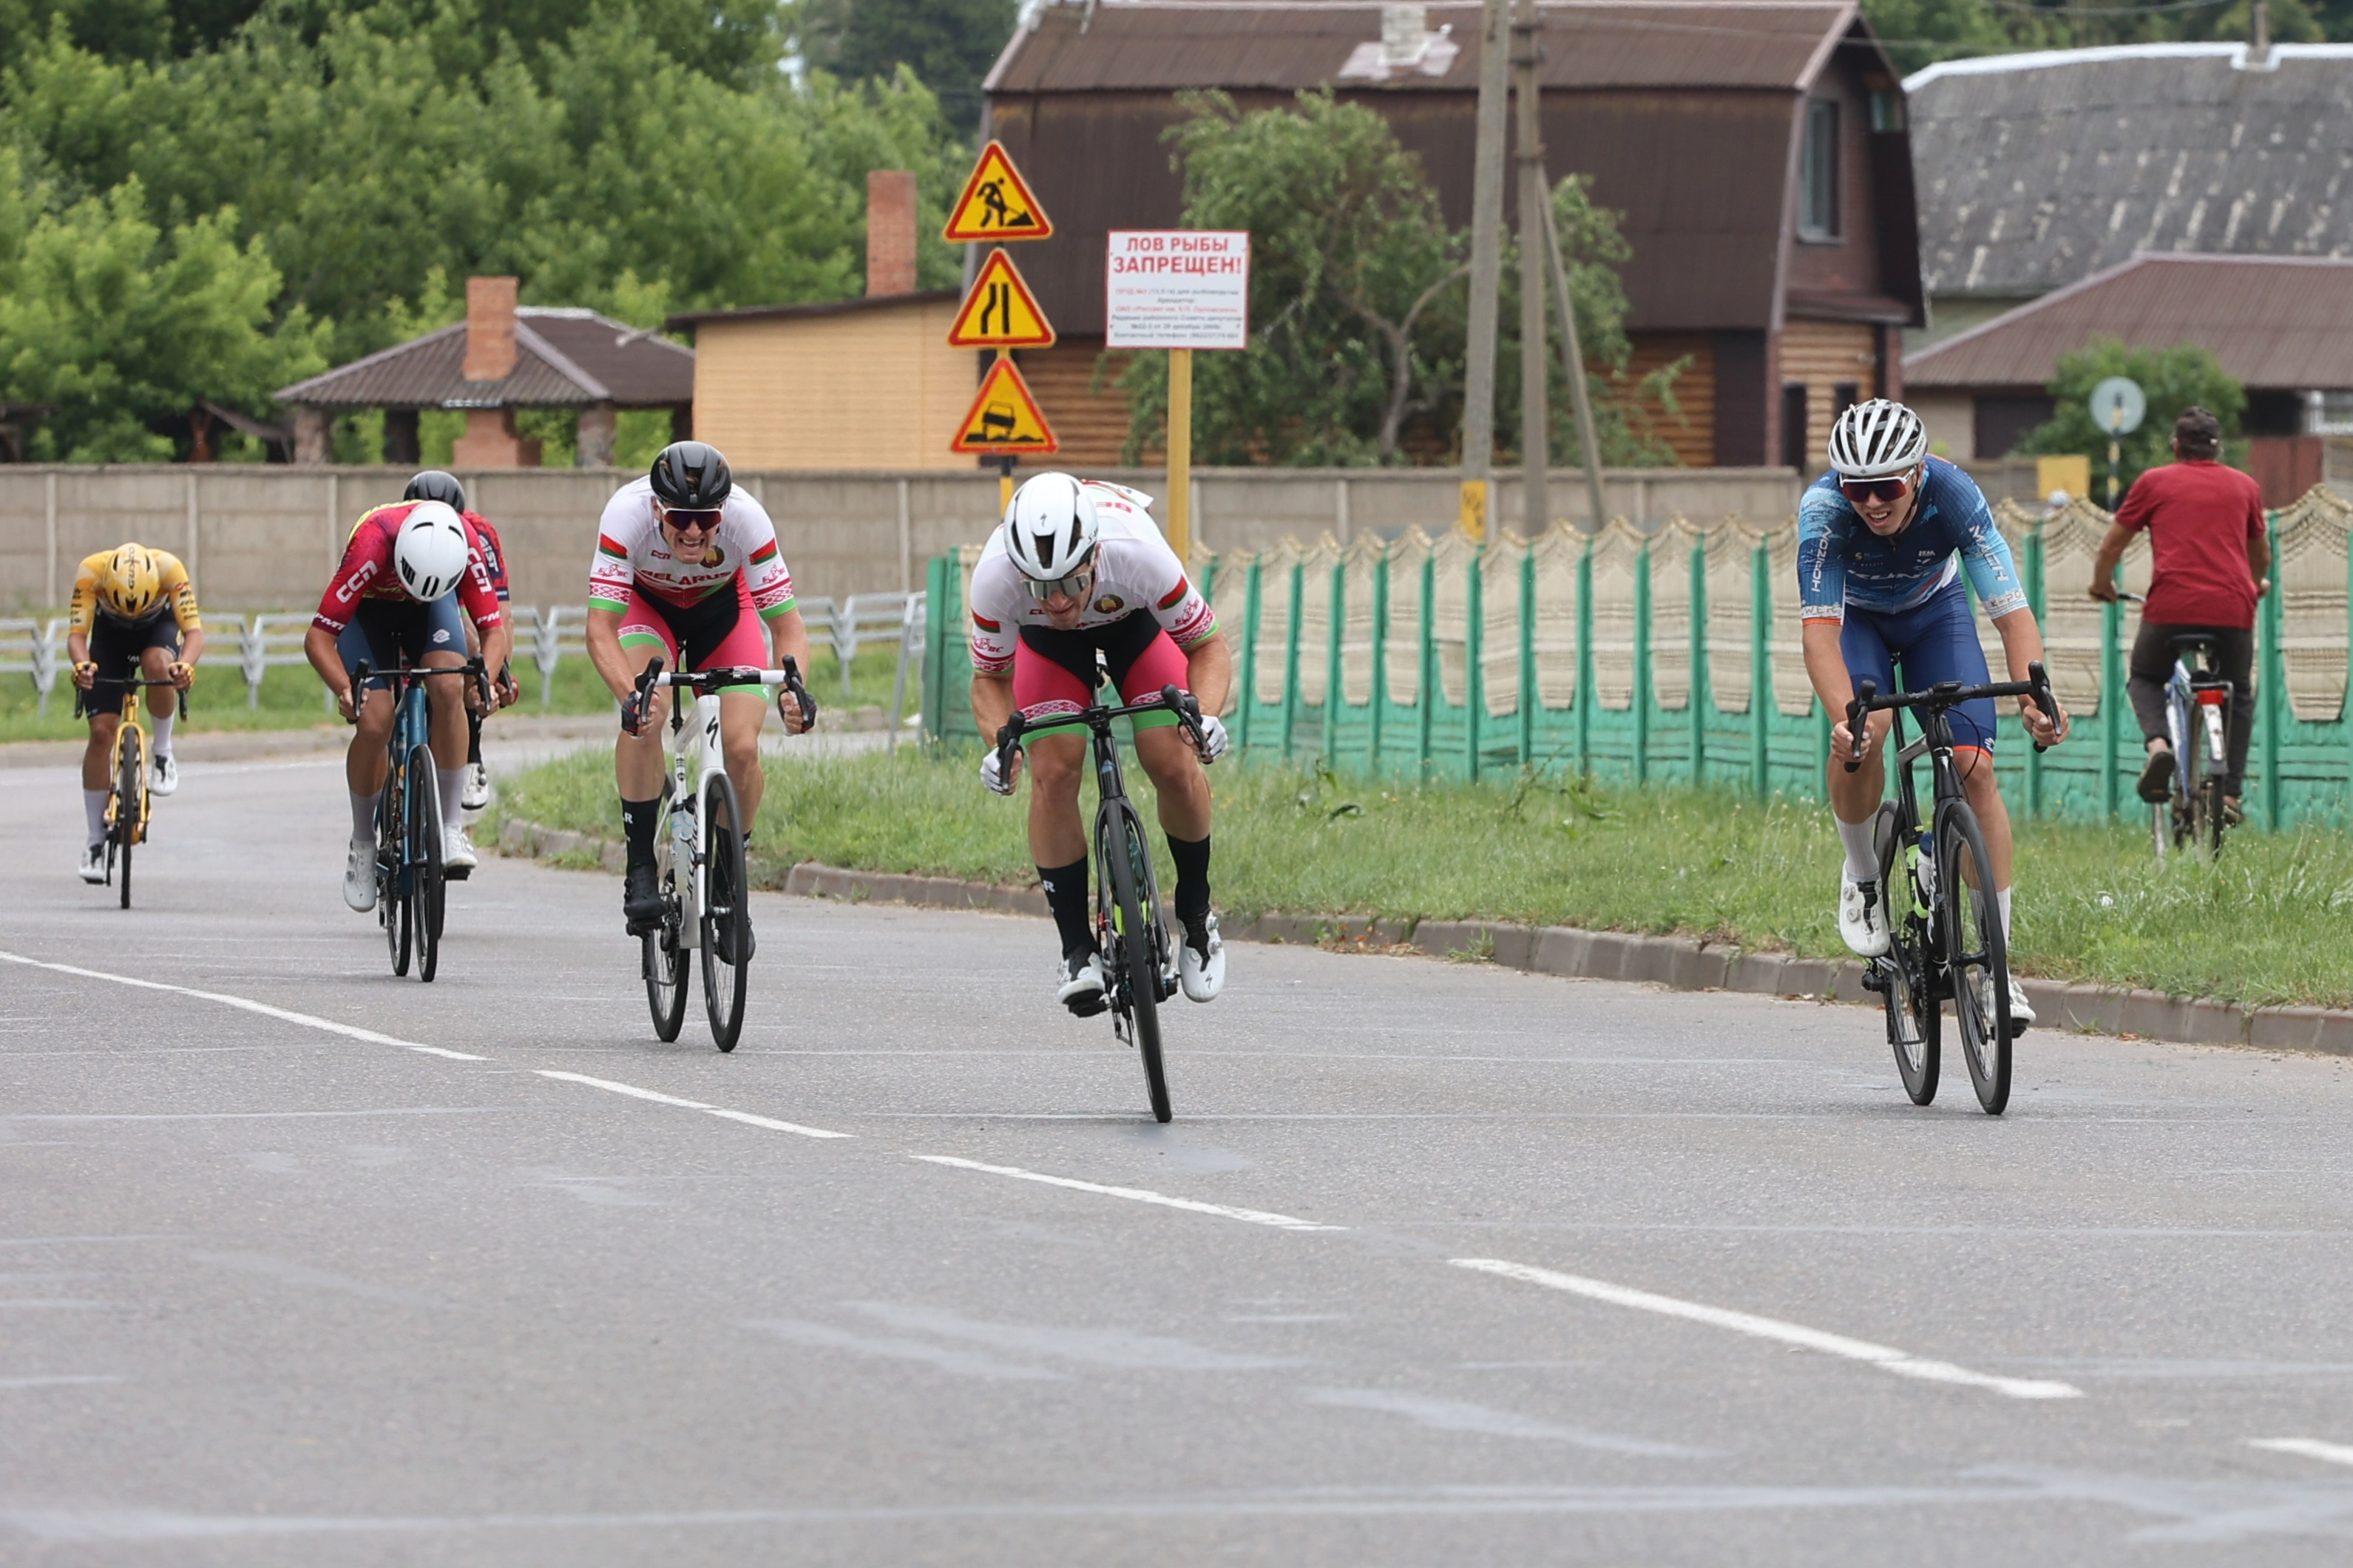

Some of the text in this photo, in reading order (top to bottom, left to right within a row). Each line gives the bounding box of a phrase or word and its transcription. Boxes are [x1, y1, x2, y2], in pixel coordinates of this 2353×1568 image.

[1126, 237, 1228, 251] ЛОВ РЫБЫ
[1113, 257, 1241, 276] ЗАПРЕЩЕН!
[1812, 525, 1832, 592] HORIZON
[640, 569, 732, 586] BELARUS
[1801, 605, 1838, 615] WER
